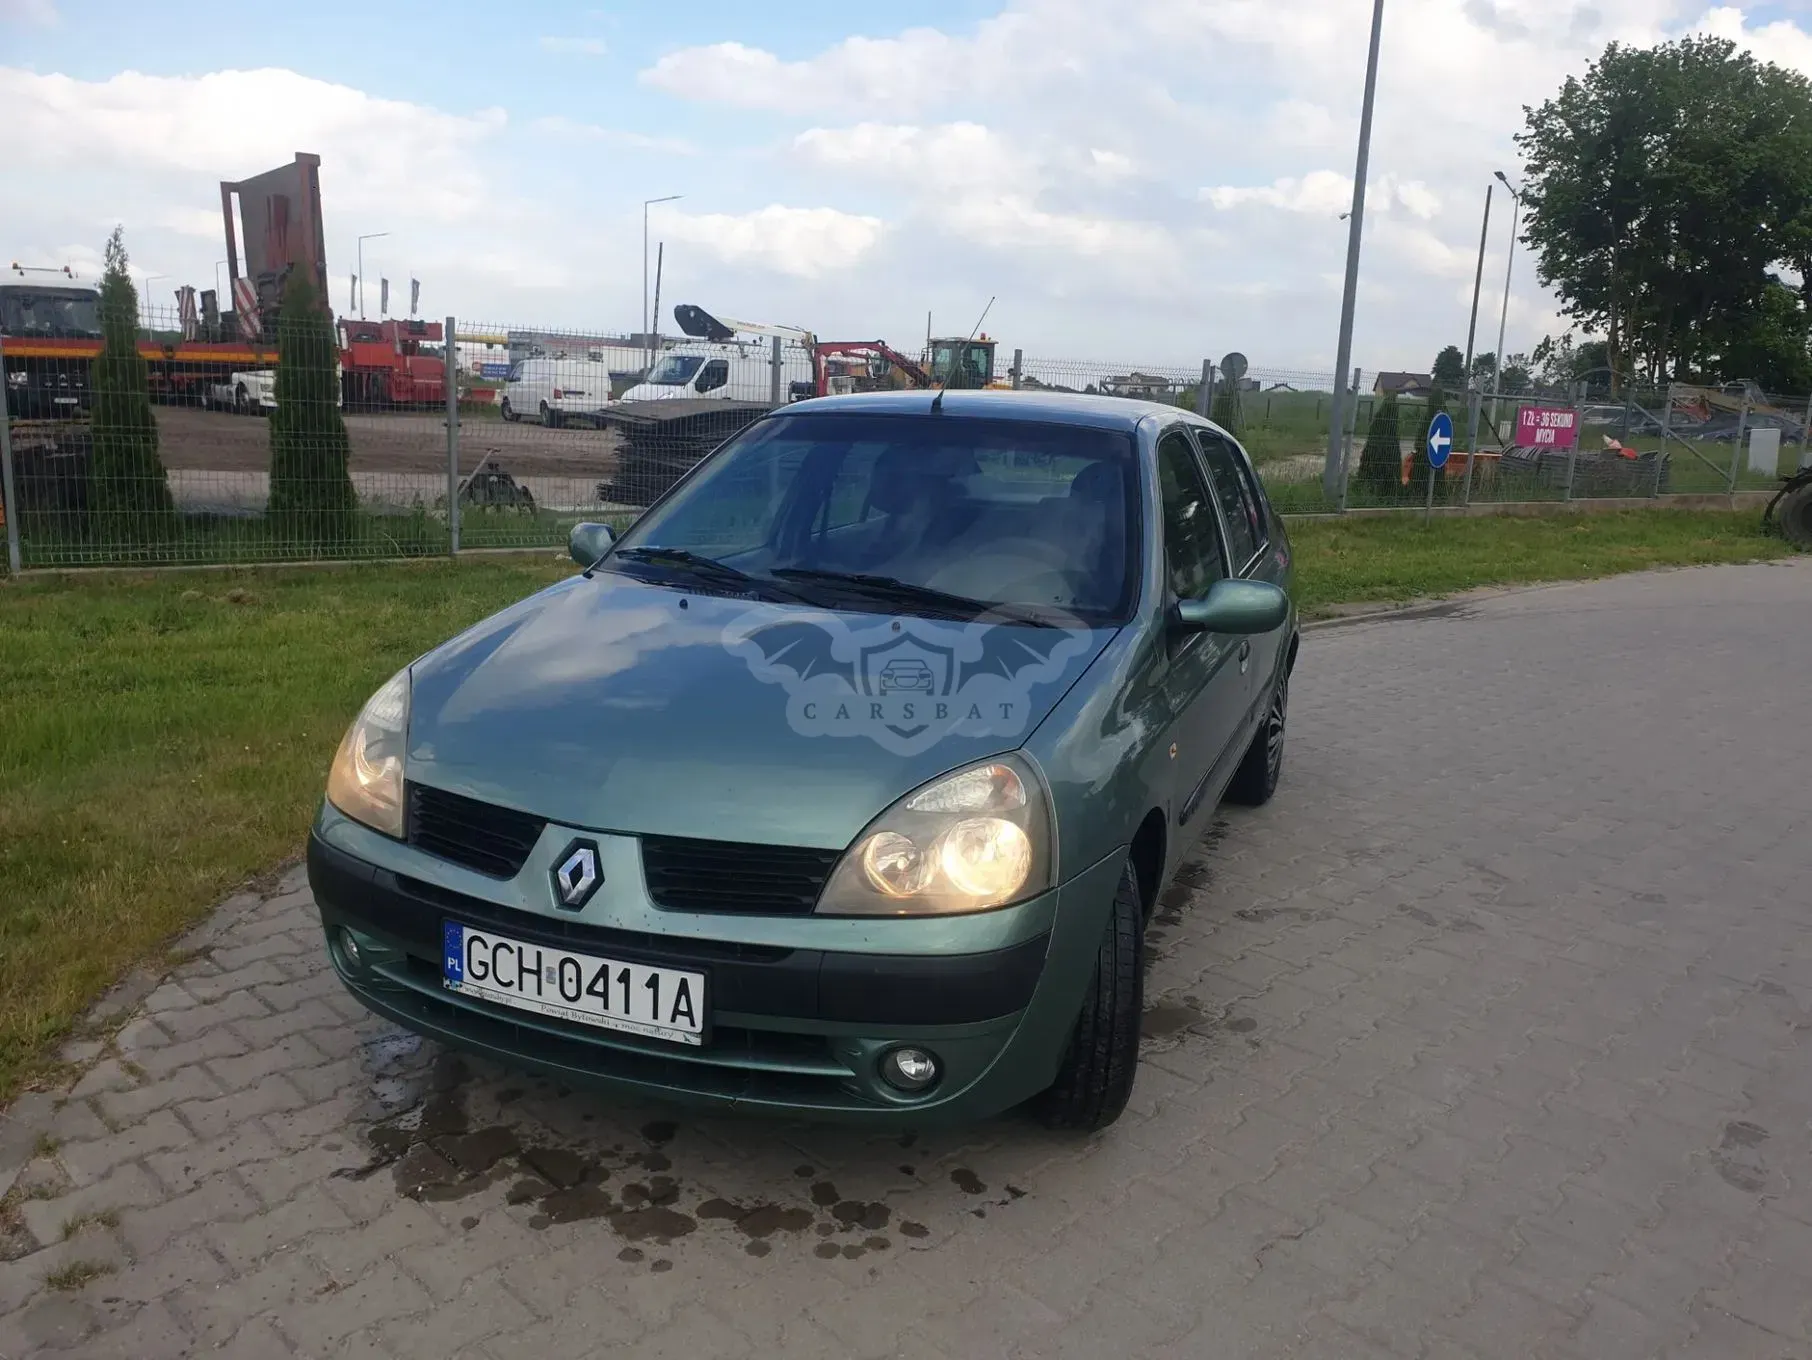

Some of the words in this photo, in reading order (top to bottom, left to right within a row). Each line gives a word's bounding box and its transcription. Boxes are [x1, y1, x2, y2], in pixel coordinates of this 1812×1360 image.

[1523, 410, 1527, 426] 1
[1550, 413, 1573, 428] SEKUND
[1535, 428, 1555, 443] MYCIA
[447, 957, 462, 972] PL
[466, 935, 543, 996] GCH
[558, 956, 697, 1028] 0411A
